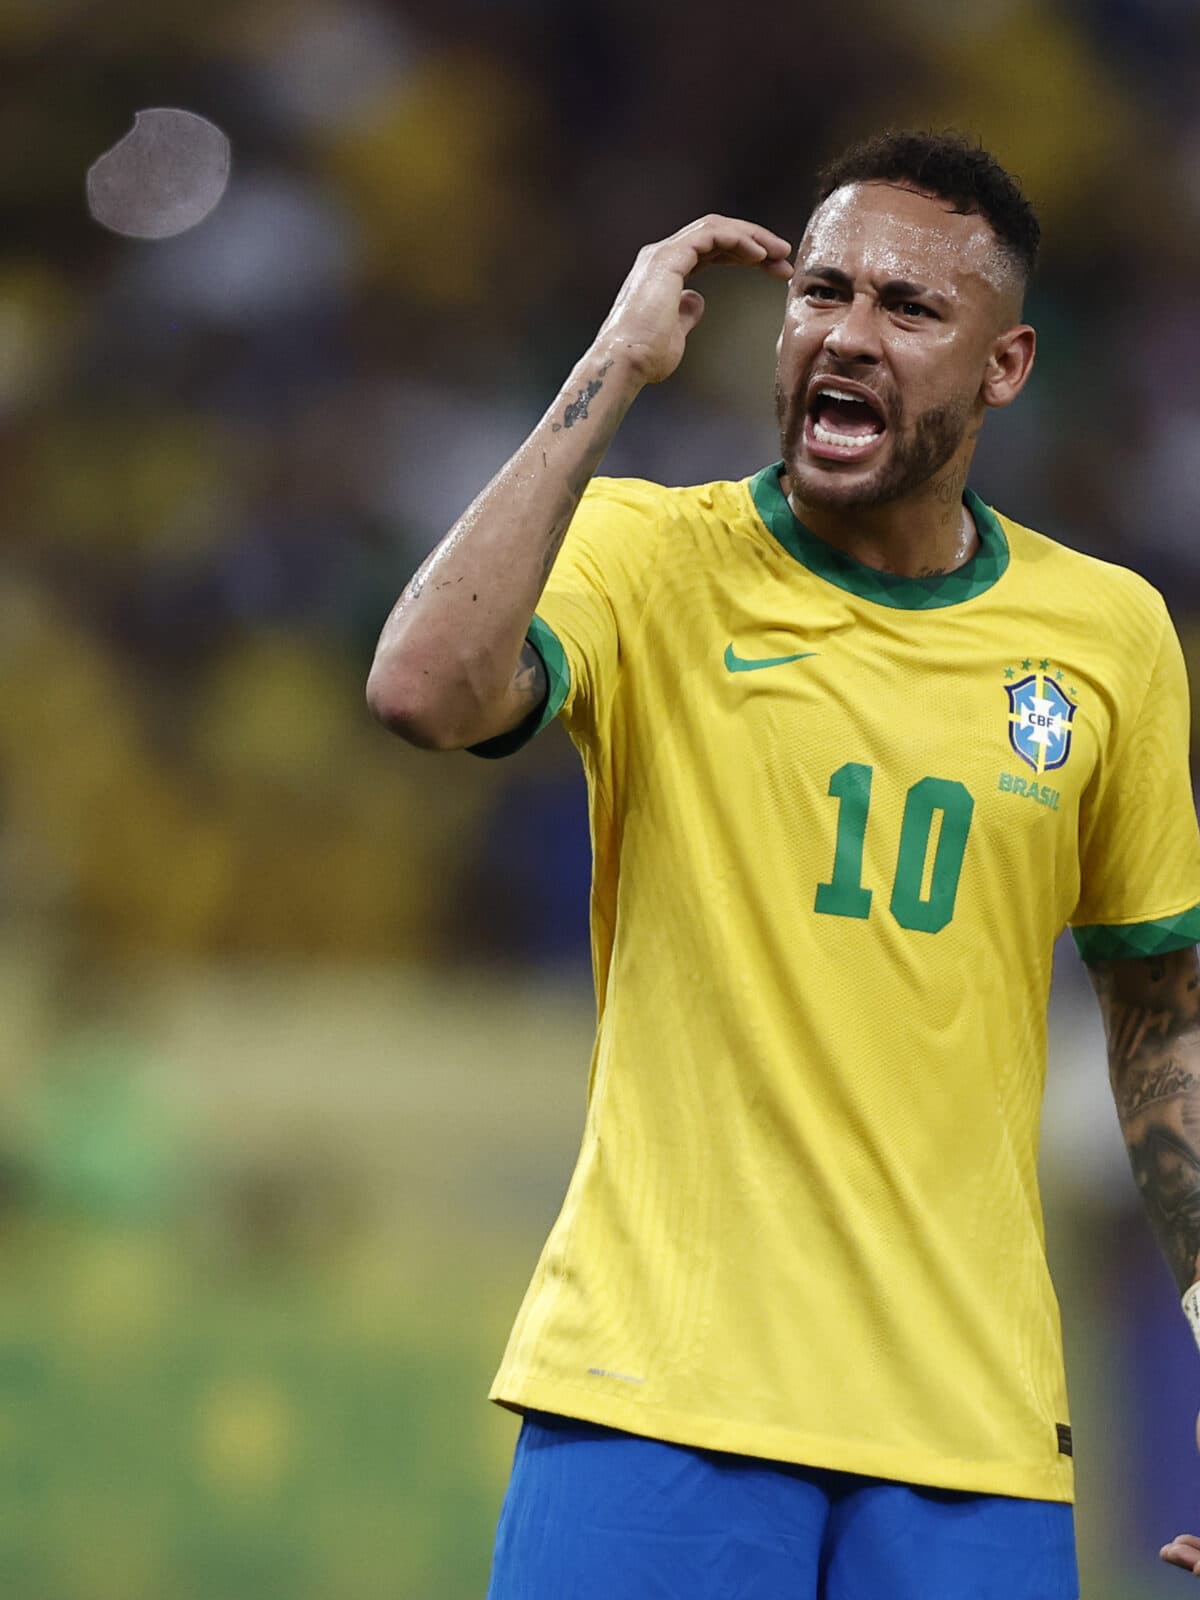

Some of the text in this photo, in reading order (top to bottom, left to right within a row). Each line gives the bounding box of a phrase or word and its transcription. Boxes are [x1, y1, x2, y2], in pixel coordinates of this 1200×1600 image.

[1028, 713, 1054, 728] CBF
[998, 772, 1060, 811] BRASIL
[814, 761, 975, 934] 10
